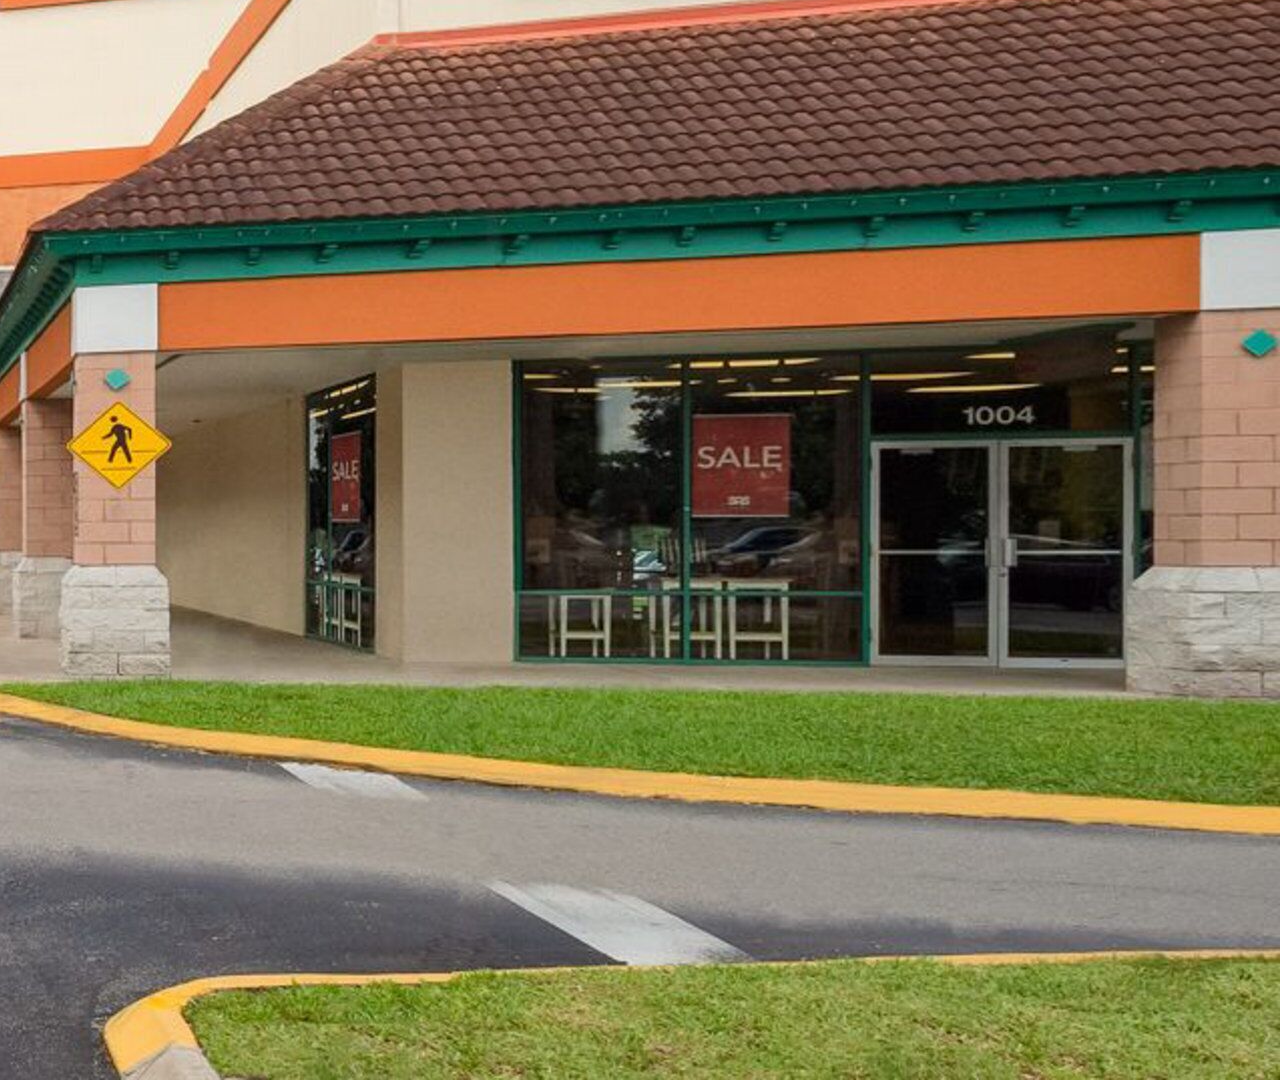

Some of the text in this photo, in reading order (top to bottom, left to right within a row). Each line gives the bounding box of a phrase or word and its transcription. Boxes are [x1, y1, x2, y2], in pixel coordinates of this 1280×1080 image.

[962, 405, 1036, 426] 1004
[696, 445, 783, 470] SALE
[332, 460, 360, 481] SALE
